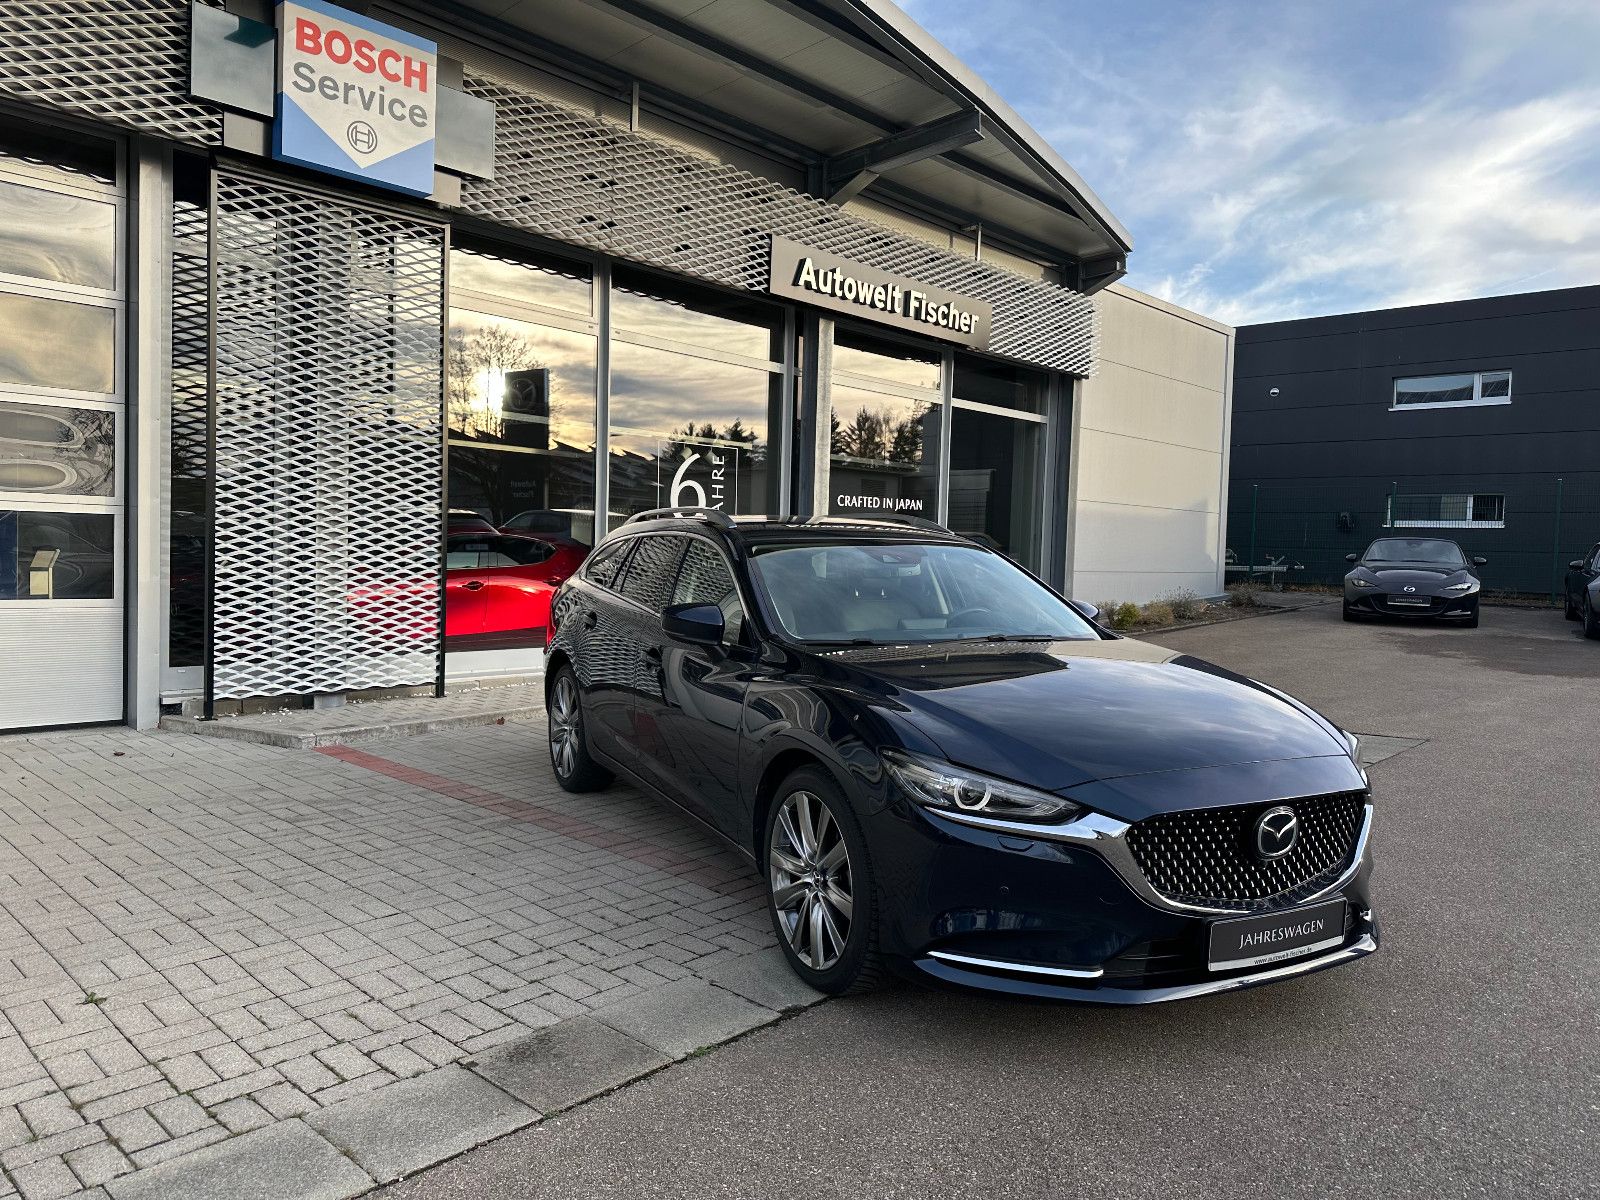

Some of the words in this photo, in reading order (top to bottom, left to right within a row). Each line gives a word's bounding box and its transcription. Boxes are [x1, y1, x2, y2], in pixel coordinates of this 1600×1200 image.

[296, 17, 428, 93] BOSCH
[292, 62, 428, 128] Service
[794, 257, 901, 314] Autowelt
[905, 289, 980, 334] Fischer
[670, 453, 708, 519] 6
[711, 455, 725, 511] AHRE
[837, 494, 880, 509] CRAFTED
[883, 497, 893, 509] IN
[895, 498, 923, 511] JAPAN
[1239, 918, 1324, 949] JAHRESWAGEN
